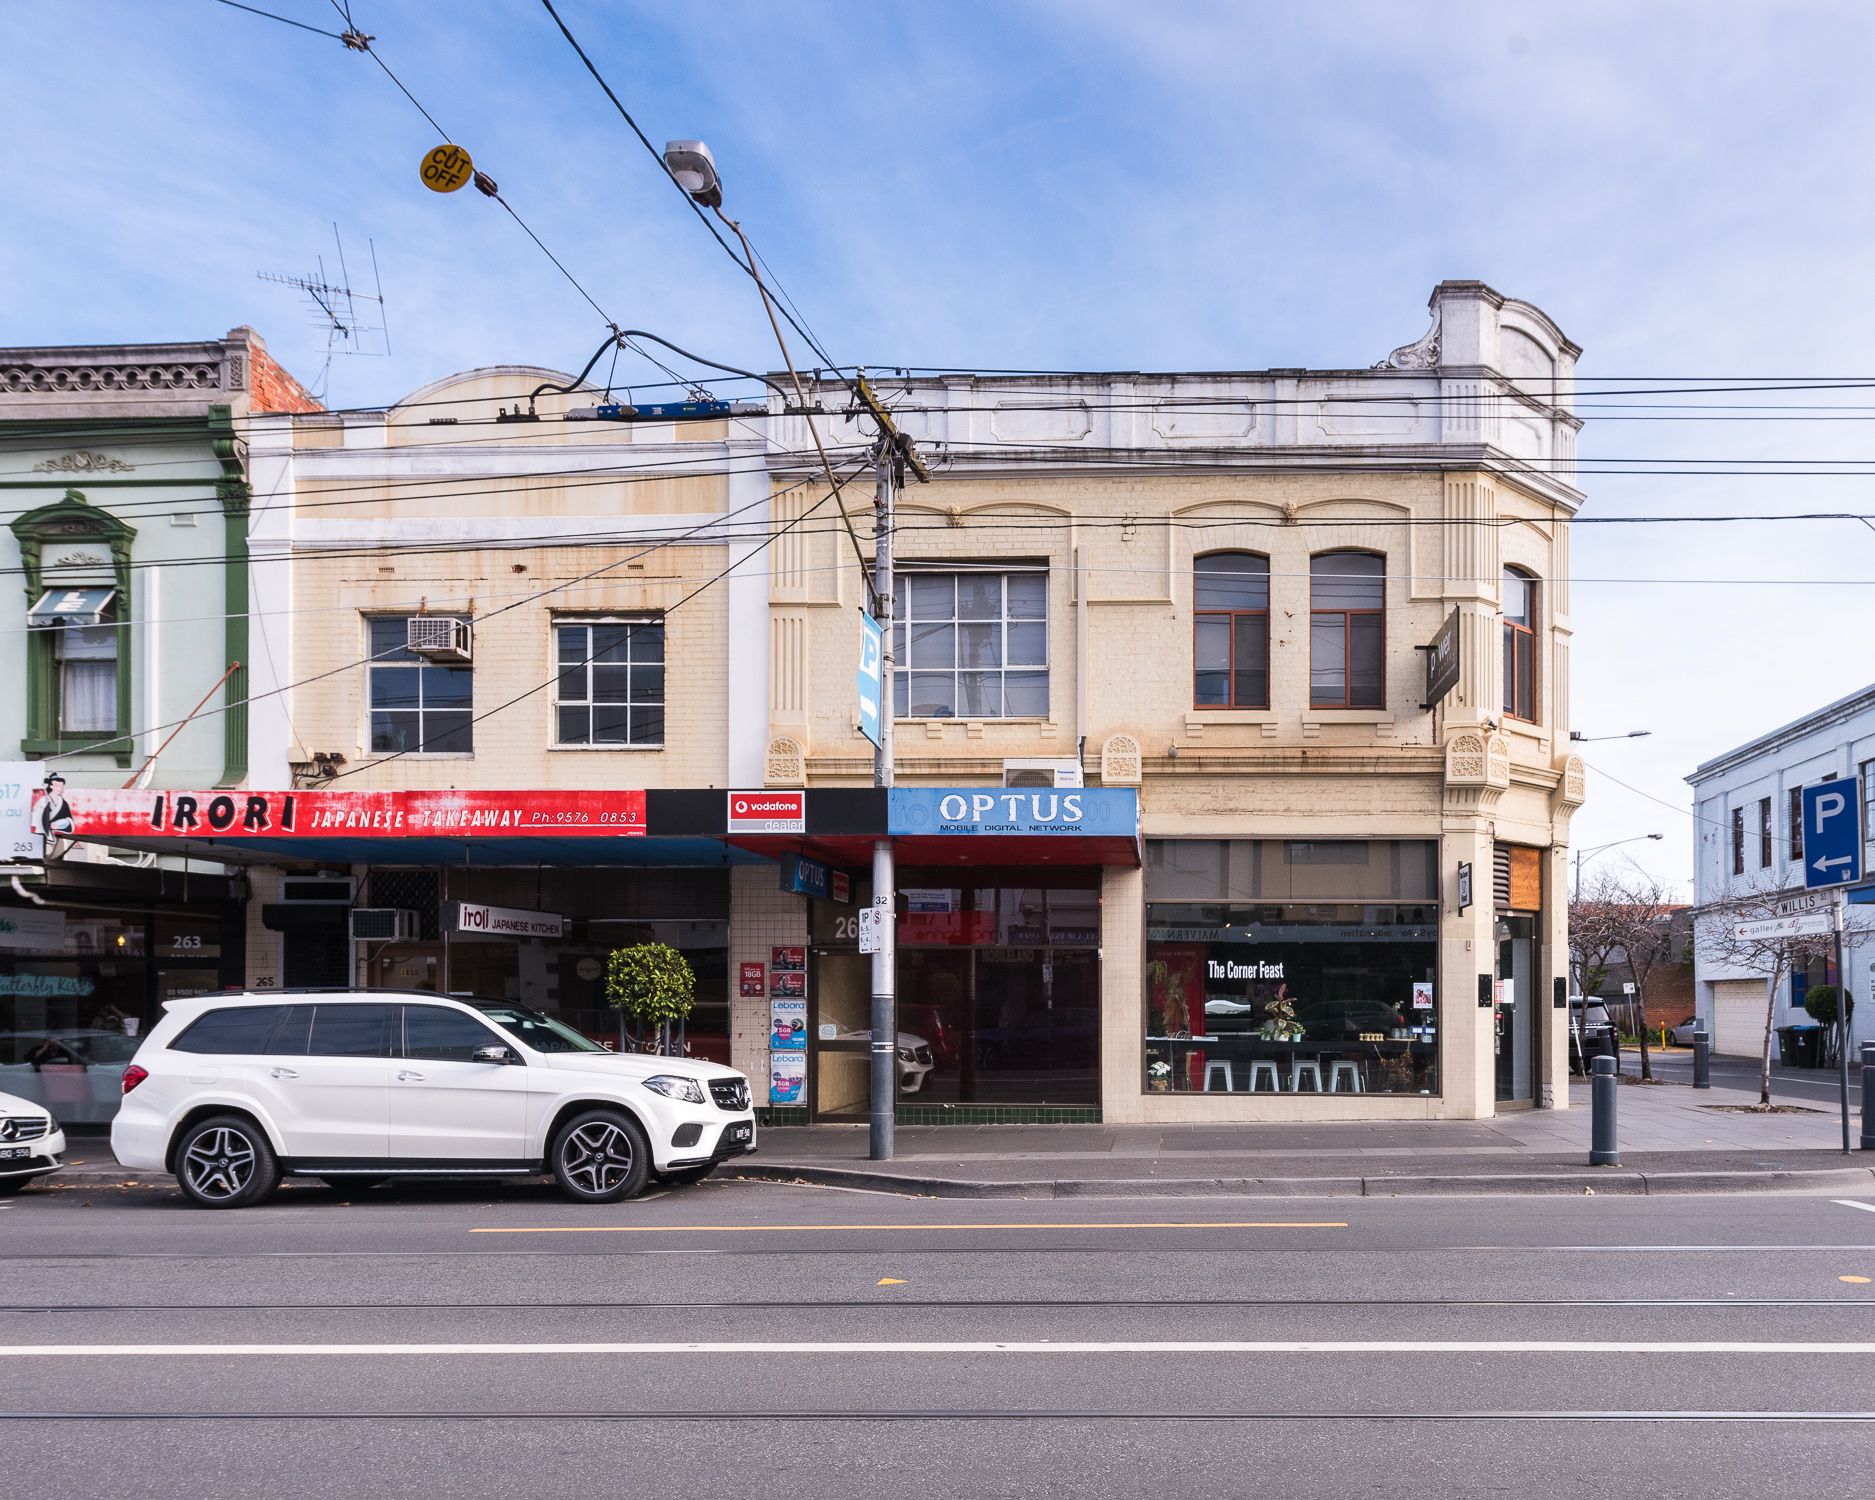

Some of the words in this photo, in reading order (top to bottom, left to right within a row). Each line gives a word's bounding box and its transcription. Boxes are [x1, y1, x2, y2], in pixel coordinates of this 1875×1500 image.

[432, 149, 470, 174] CUT
[424, 165, 460, 187] OFF
[863, 632, 877, 669] P
[150, 795, 297, 833] IRORI
[750, 801, 798, 811] vodafone
[939, 794, 1083, 822] OPTUS
[1815, 792, 1846, 834] P
[311, 810, 404, 828] JAPANESE
[422, 809, 523, 828] TAKEAWAY
[600, 811, 637, 823] 0853
[765, 820, 803, 830] dealer
[940, 824, 979, 832] MOBILE
[984, 824, 1024, 832] DIGITAL
[1029, 824, 1083, 832] NETWORK
[13, 842, 33, 852] 263
[798, 860, 825, 888] OPTUS
[875, 896, 888, 905] 32
[1780, 896, 1816, 915] WILLIS
[491, 919, 529, 932] JAPANESE
[530, 923, 560, 935] KITCHEN
[835, 917, 859, 939] 26
[173, 936, 201, 949] 263
[744, 970, 761, 978] 18GB
[1208, 961, 1225, 978] The
[1227, 961, 1257, 978] Corner
[1259, 961, 1284, 978] Feast
[0, 976, 52, 996] utterfly
[256, 977, 274, 987] 265
[772, 1055, 804, 1063] Lebara
